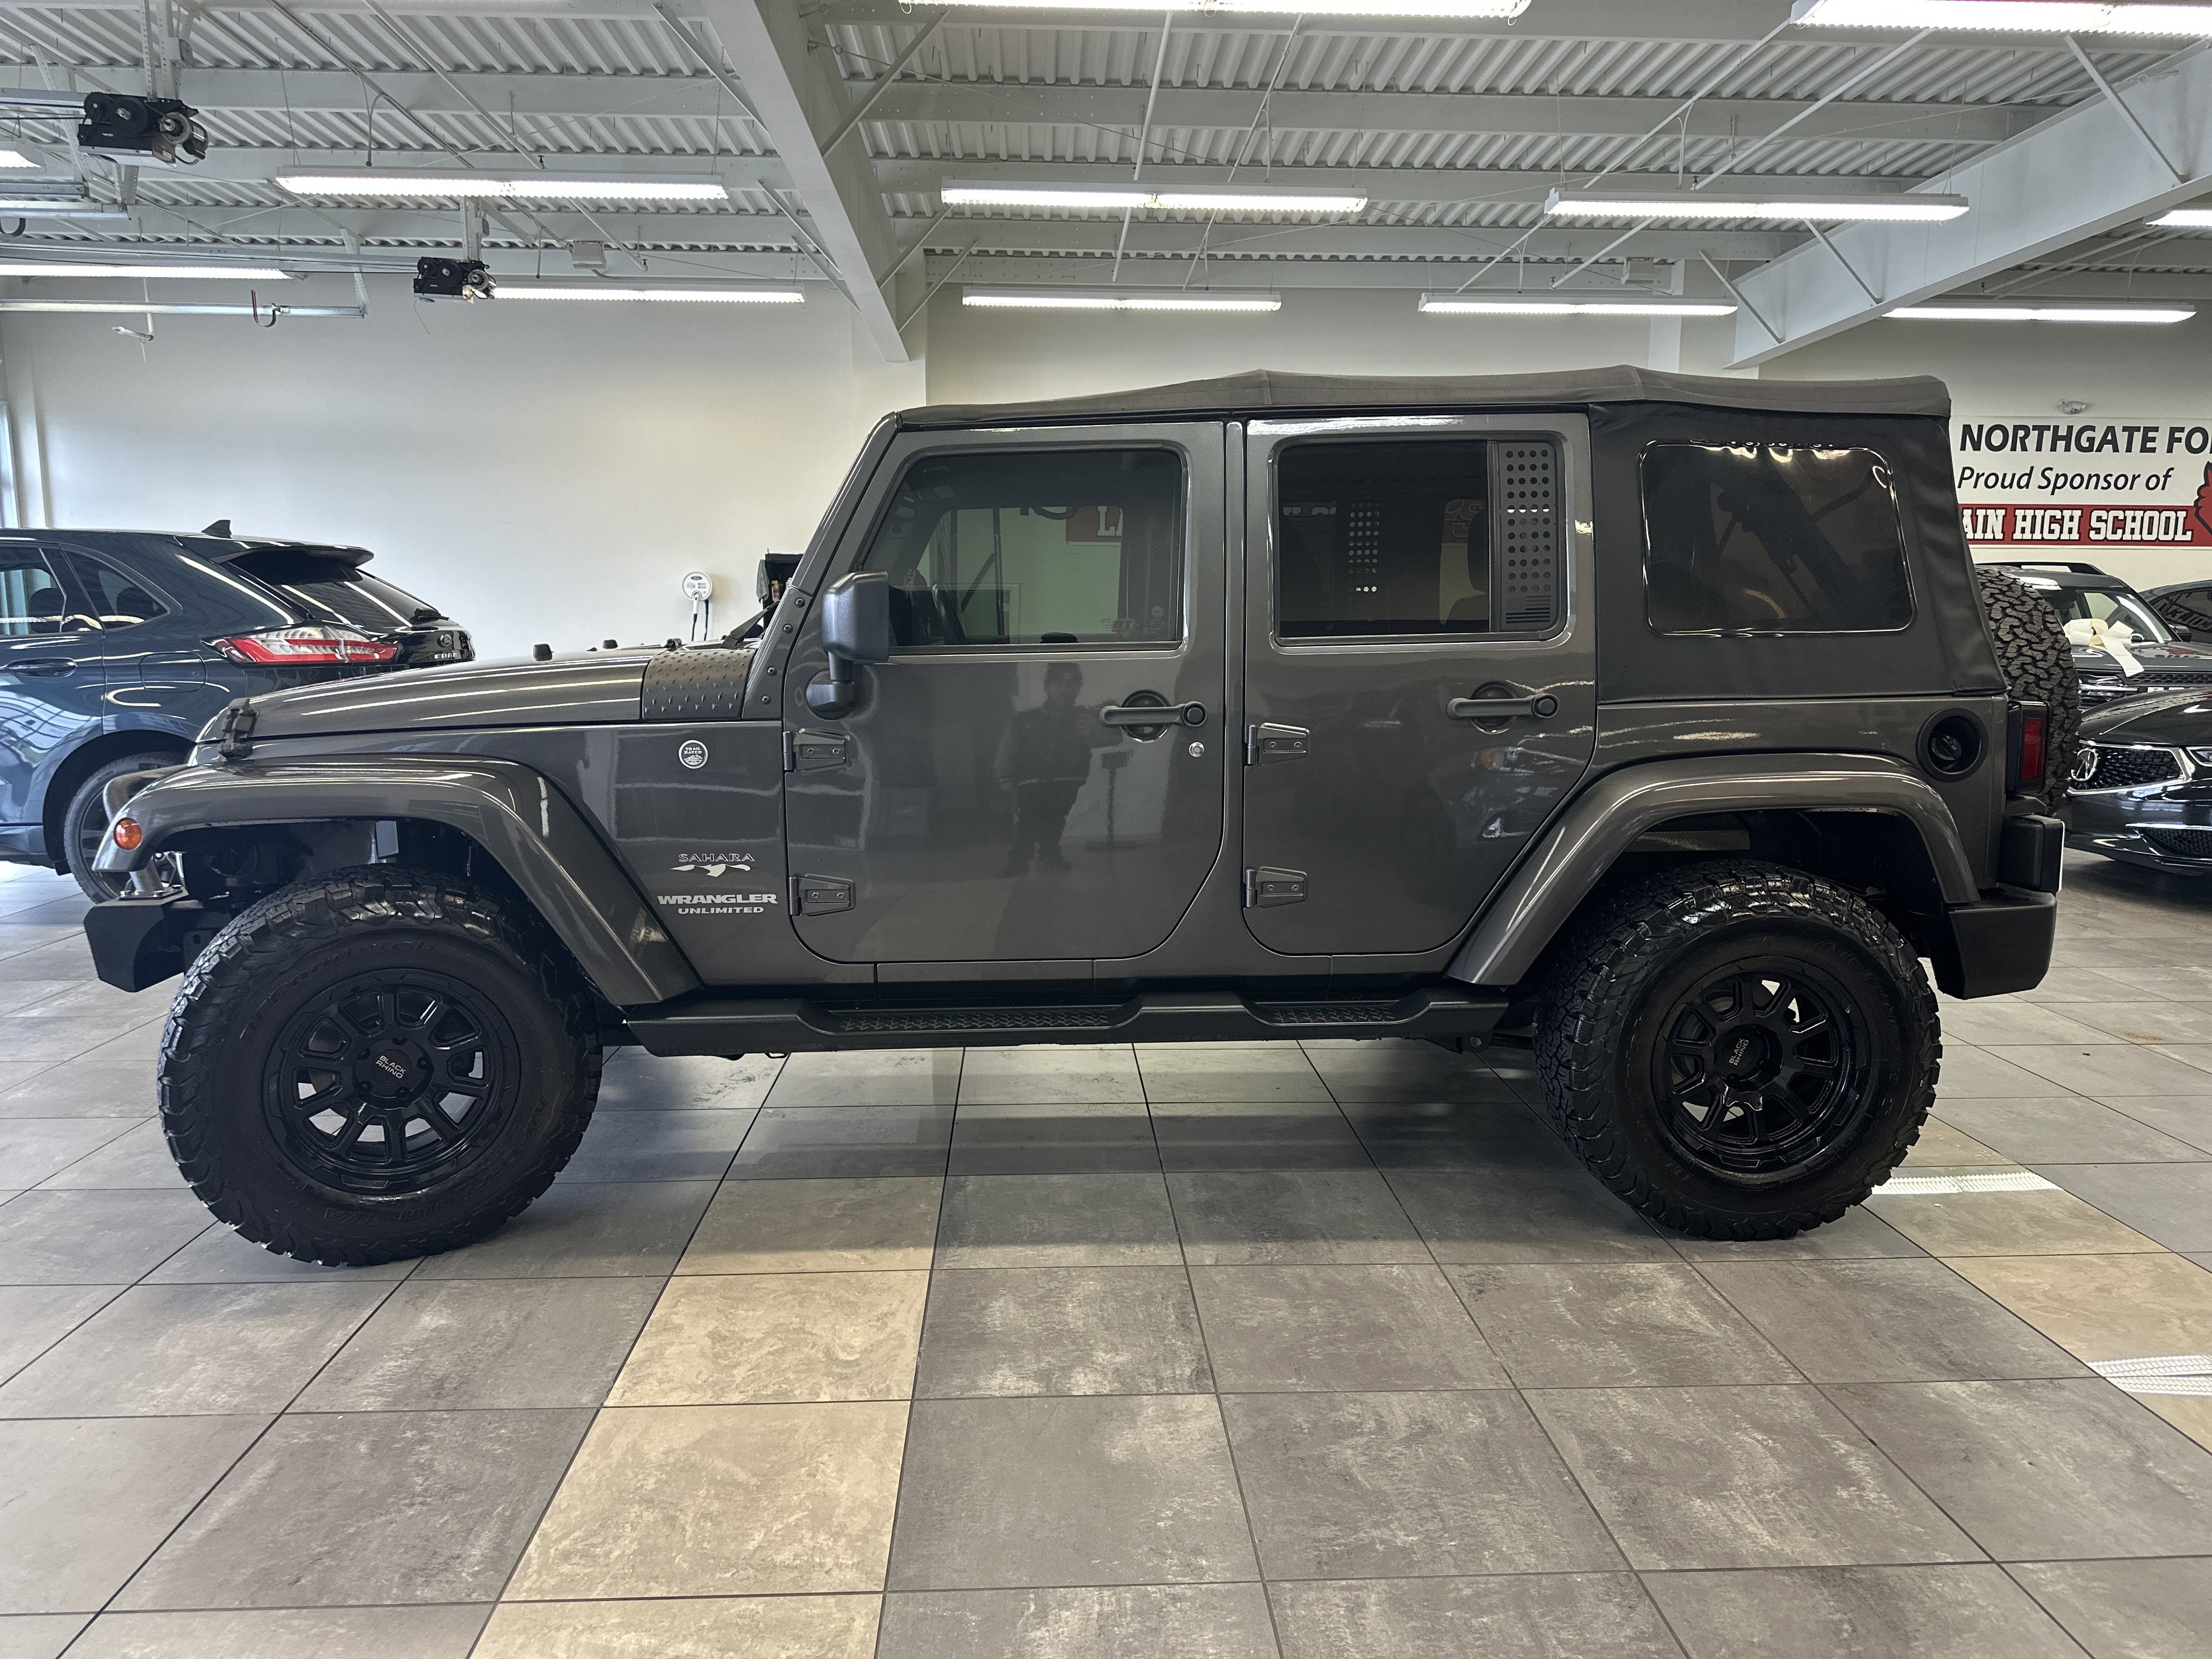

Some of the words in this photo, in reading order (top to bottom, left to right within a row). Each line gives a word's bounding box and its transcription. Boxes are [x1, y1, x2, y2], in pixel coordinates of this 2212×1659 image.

[1960, 424, 2159, 454] NORTHGATE
[2166, 426, 2212, 454] FO
[1957, 466, 2034, 490] Proud
[2037, 467, 2141, 495] Sponsor
[2145, 467, 2175, 491] of
[2013, 508, 2083, 541] HIGH
[2089, 509, 2193, 542] SCHOOL
[678, 853, 755, 862] SAHARA
[657, 893, 778, 905] WRANGLER
[678, 906, 765, 915] UNLIMITED
[1729, 1037, 1745, 1064] BLACK
[1734, 1040, 1749, 1065] RHINO
[375, 1060, 403, 1079] RHINO
[379, 1055, 407, 1074] BLACK
